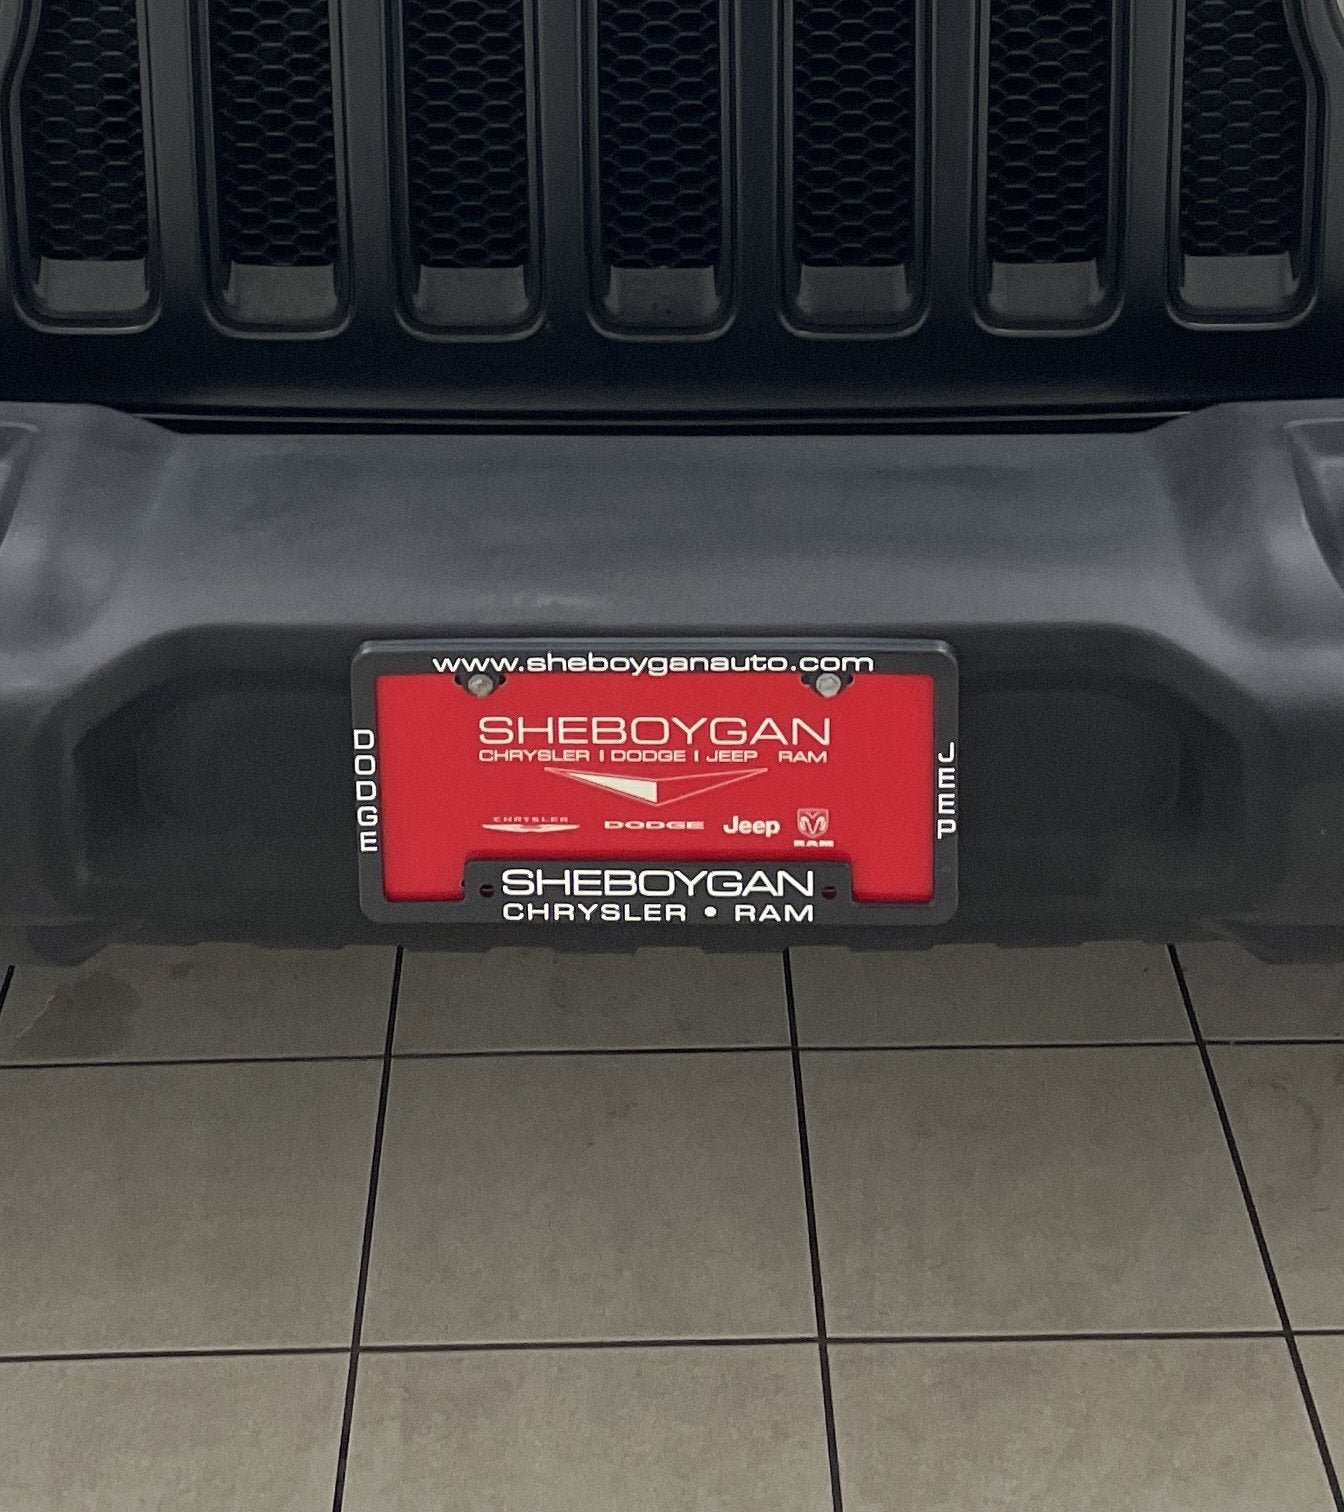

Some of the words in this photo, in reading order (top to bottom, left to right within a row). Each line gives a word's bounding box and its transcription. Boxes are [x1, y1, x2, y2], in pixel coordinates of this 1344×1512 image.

[432, 653, 874, 677] www.sheboyganauto.com
[478, 717, 830, 746] SHEBOYGAN
[478, 749, 590, 763] CHRYSLER
[610, 749, 686, 763] DODGE
[706, 749, 759, 763] JEEP
[778, 750, 828, 763] RAM
[353, 728, 378, 852] DODGE
[937, 741, 956, 840] JEEP
[604, 821, 705, 830] DODGE
[723, 815, 780, 837] Jeep
[793, 840, 834, 848] RAM
[501, 869, 814, 897] SHEBOYGAN
[502, 903, 686, 922] CHRYSLER
[734, 904, 814, 922] RAM
